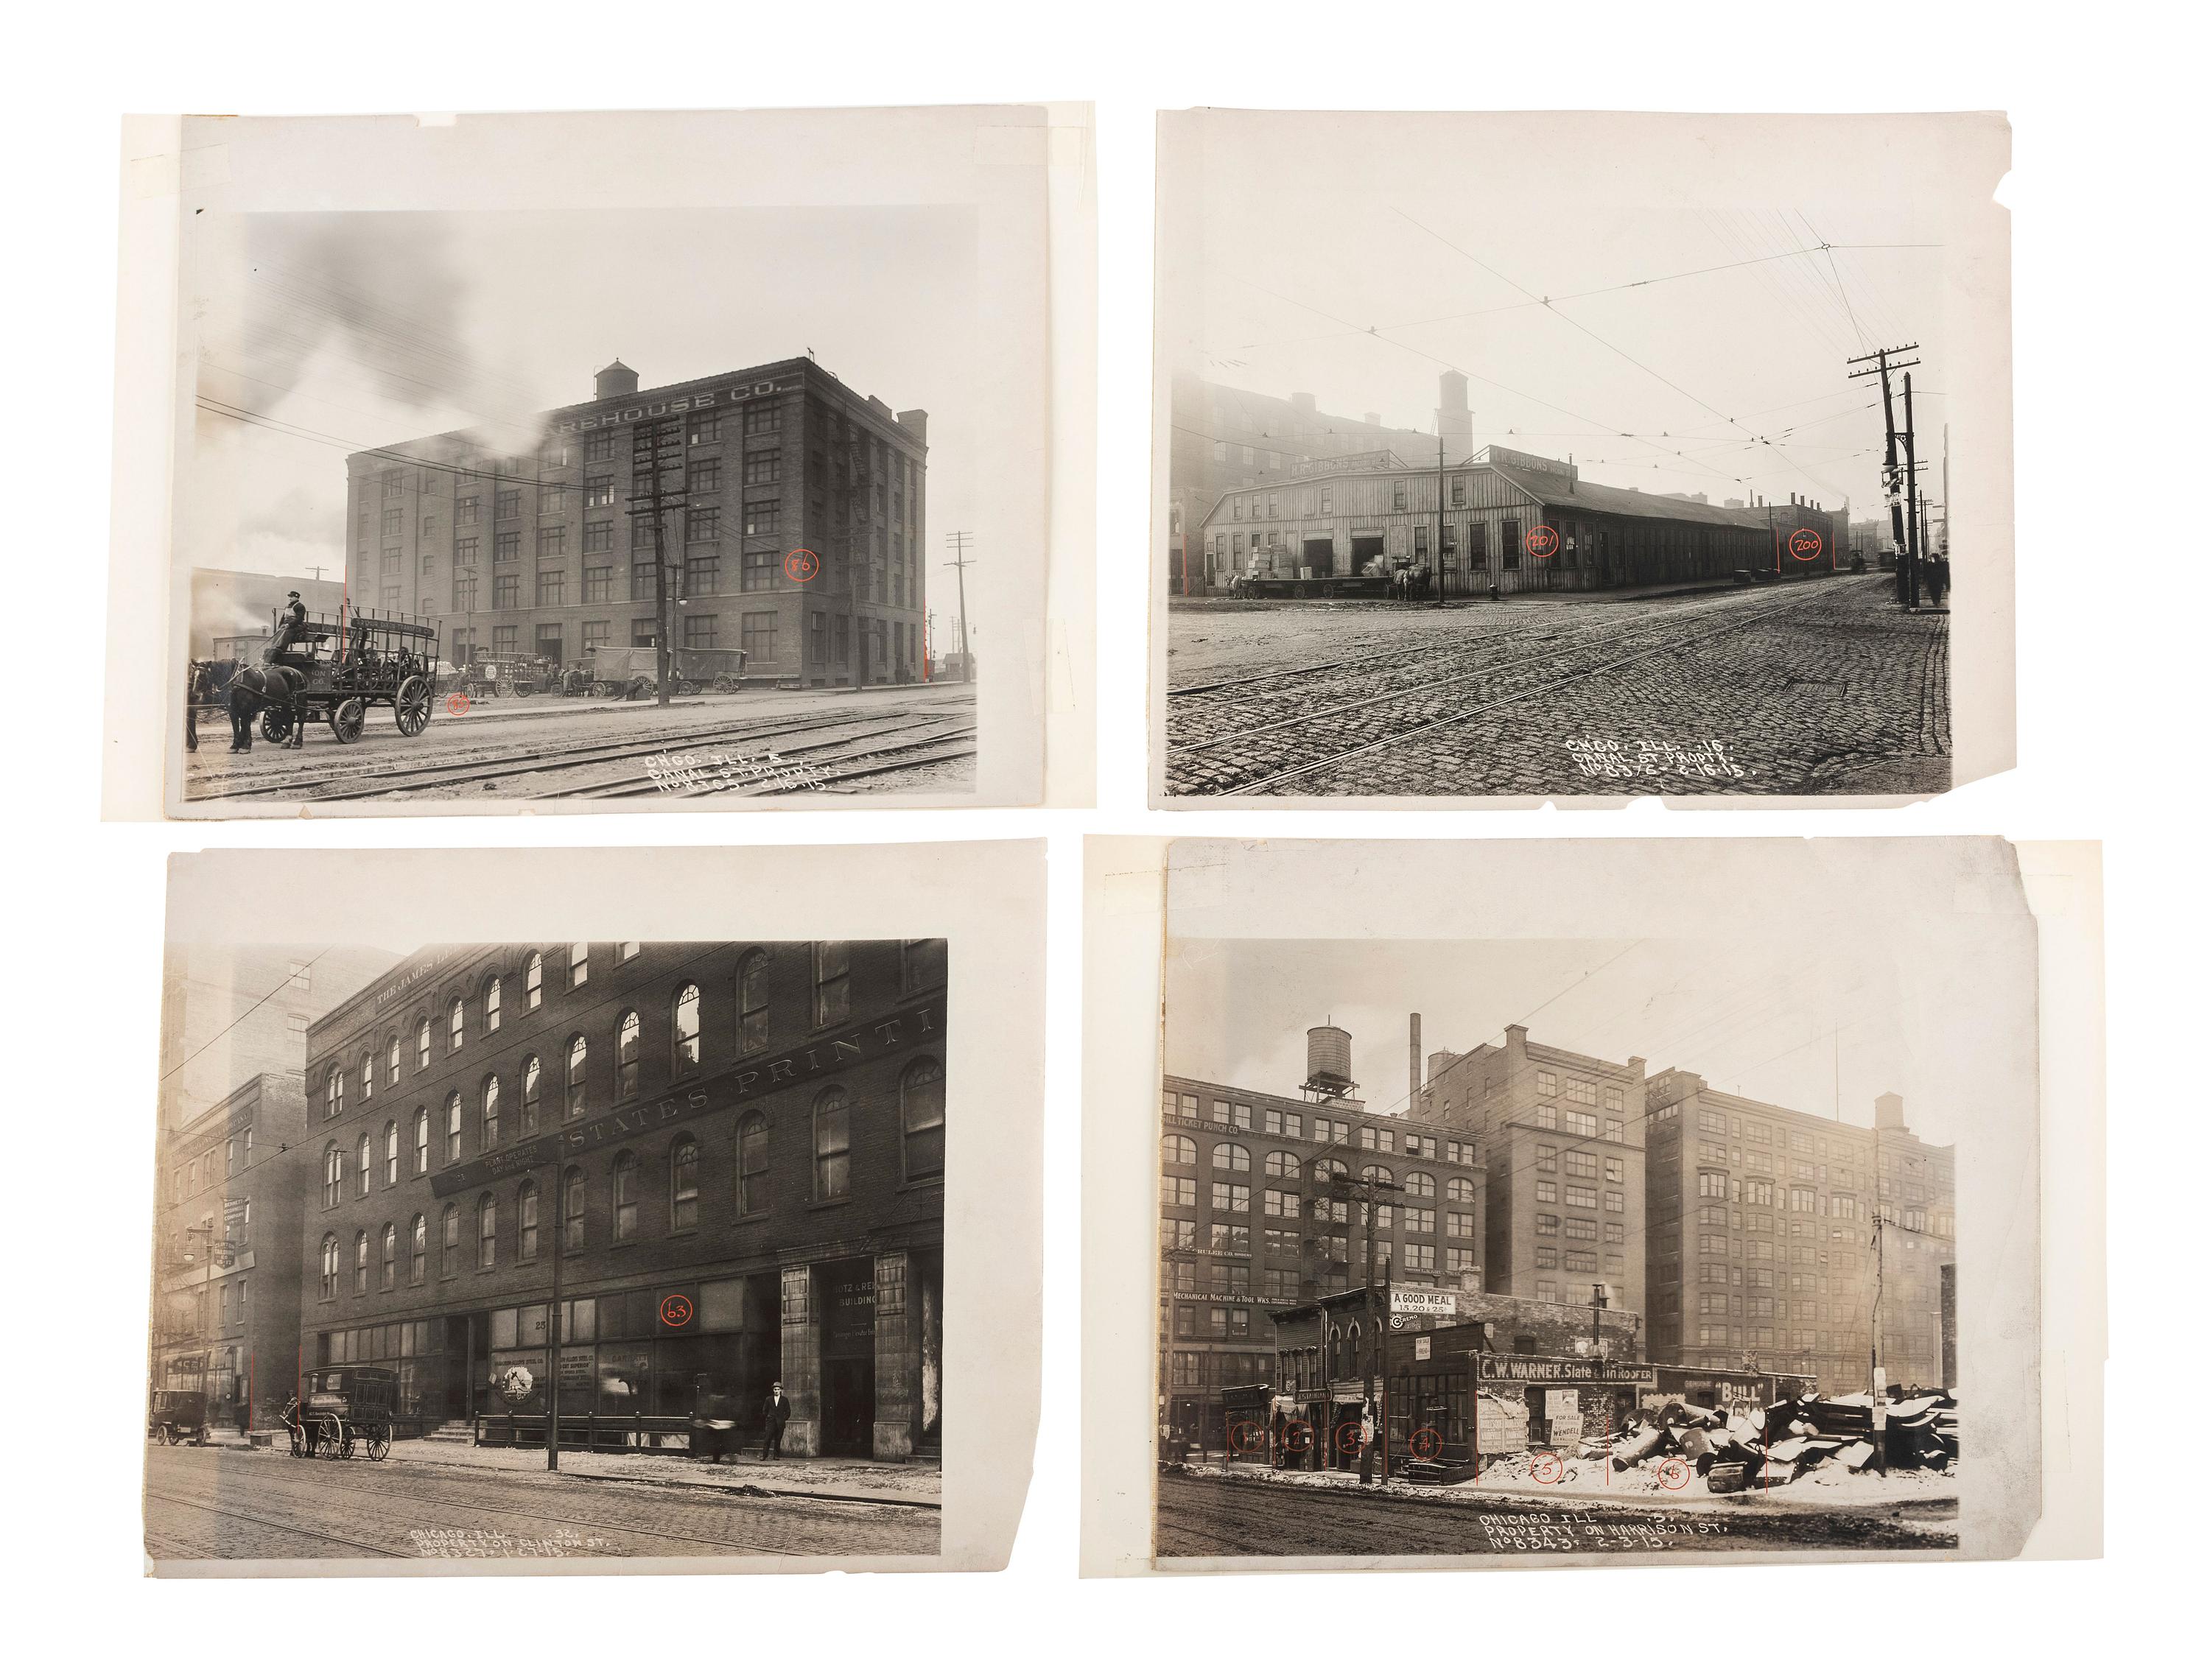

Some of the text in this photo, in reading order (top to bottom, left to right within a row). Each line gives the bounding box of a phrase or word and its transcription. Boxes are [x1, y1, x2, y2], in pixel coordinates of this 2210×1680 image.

[731, 382, 782, 401] CO.
[1531, 535, 1554, 547] 201
[1795, 540, 1818, 551] 200
[1572, 752, 1633, 765] CANAL
[648, 767, 710, 781] CANAL
[377, 960, 433, 1005] THE JAMES
[568, 1008, 934, 1148] STATES PRINTI
[1177, 1117, 1202, 1129] TICKET
[1204, 1121, 1227, 1133] PUNCH
[485, 1145, 538, 1168] PLANT OPERATES
[491, 1166, 503, 1175] DAY
[516, 1155, 534, 1168] NIGHT
[1174, 1292, 1207, 1301] MECHANICAL
[1210, 1293, 1235, 1302] MACHINE
[1395, 1293, 1451, 1305] A GOOD MEAL
[1400, 1315, 1418, 1323] CREMO
[1565, 1364, 1591, 1378] Slate
[1554, 1427, 1579, 1437] WENDELL
[1479, 1514, 1551, 1526] CHICAGO
[1560, 1514, 1597, 1524] ILL
[1484, 1525, 1574, 1537] PROPERTY
[1585, 1525, 1604, 1536] ON
[1610, 1523, 1694, 1536] HARRISON
[416, 1539, 487, 1547] PROPERTY
[519, 1539, 582, 1547] CLINTON
